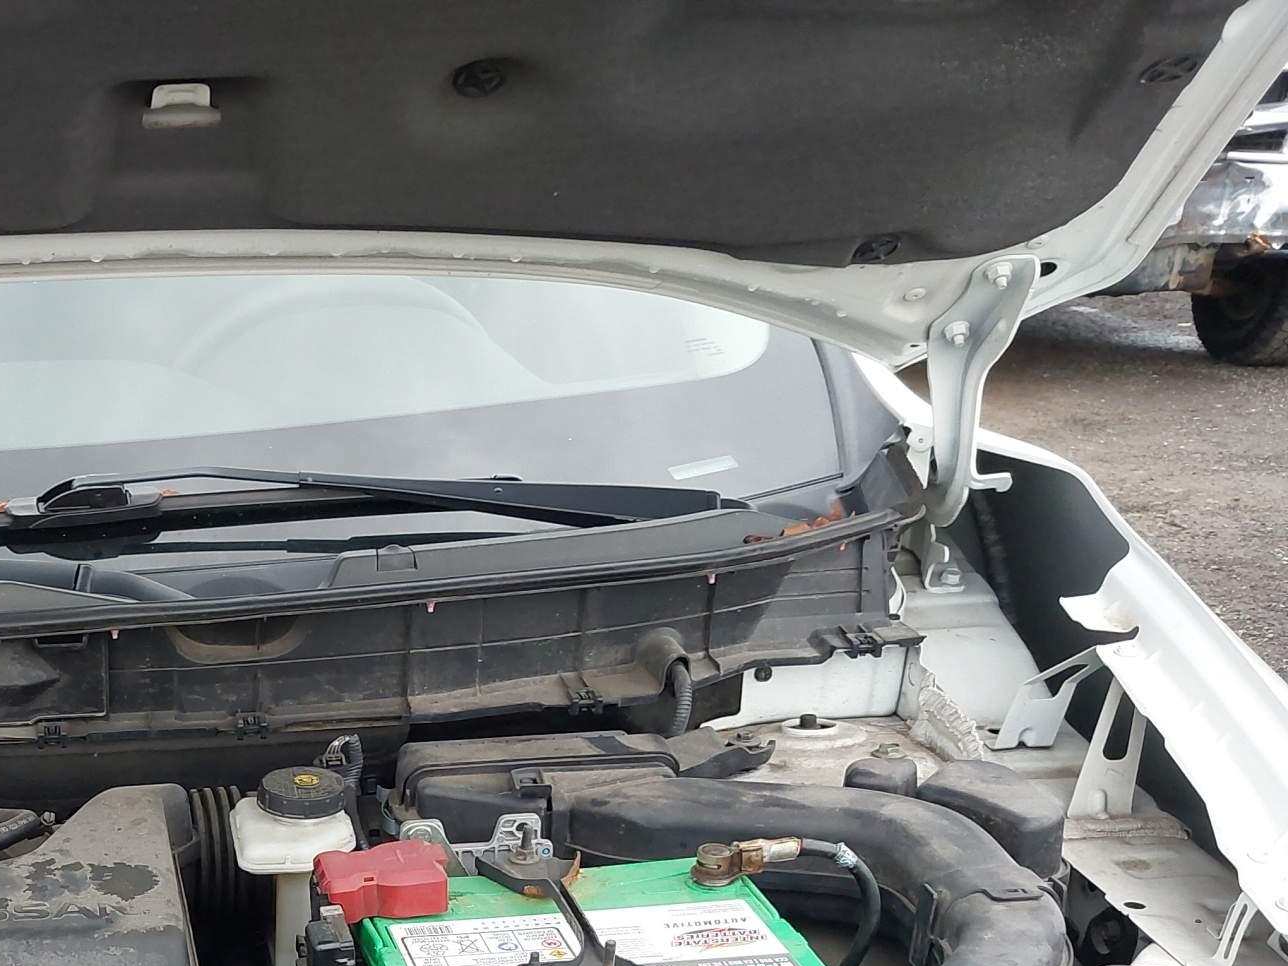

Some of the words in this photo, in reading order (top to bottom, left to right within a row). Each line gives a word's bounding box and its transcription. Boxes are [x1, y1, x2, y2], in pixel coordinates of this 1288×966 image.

[664, 917, 747, 929] AUTOMOTIVE
[671, 934, 767, 947] INTERSTATE
[673, 929, 759, 941] BATTERIES
